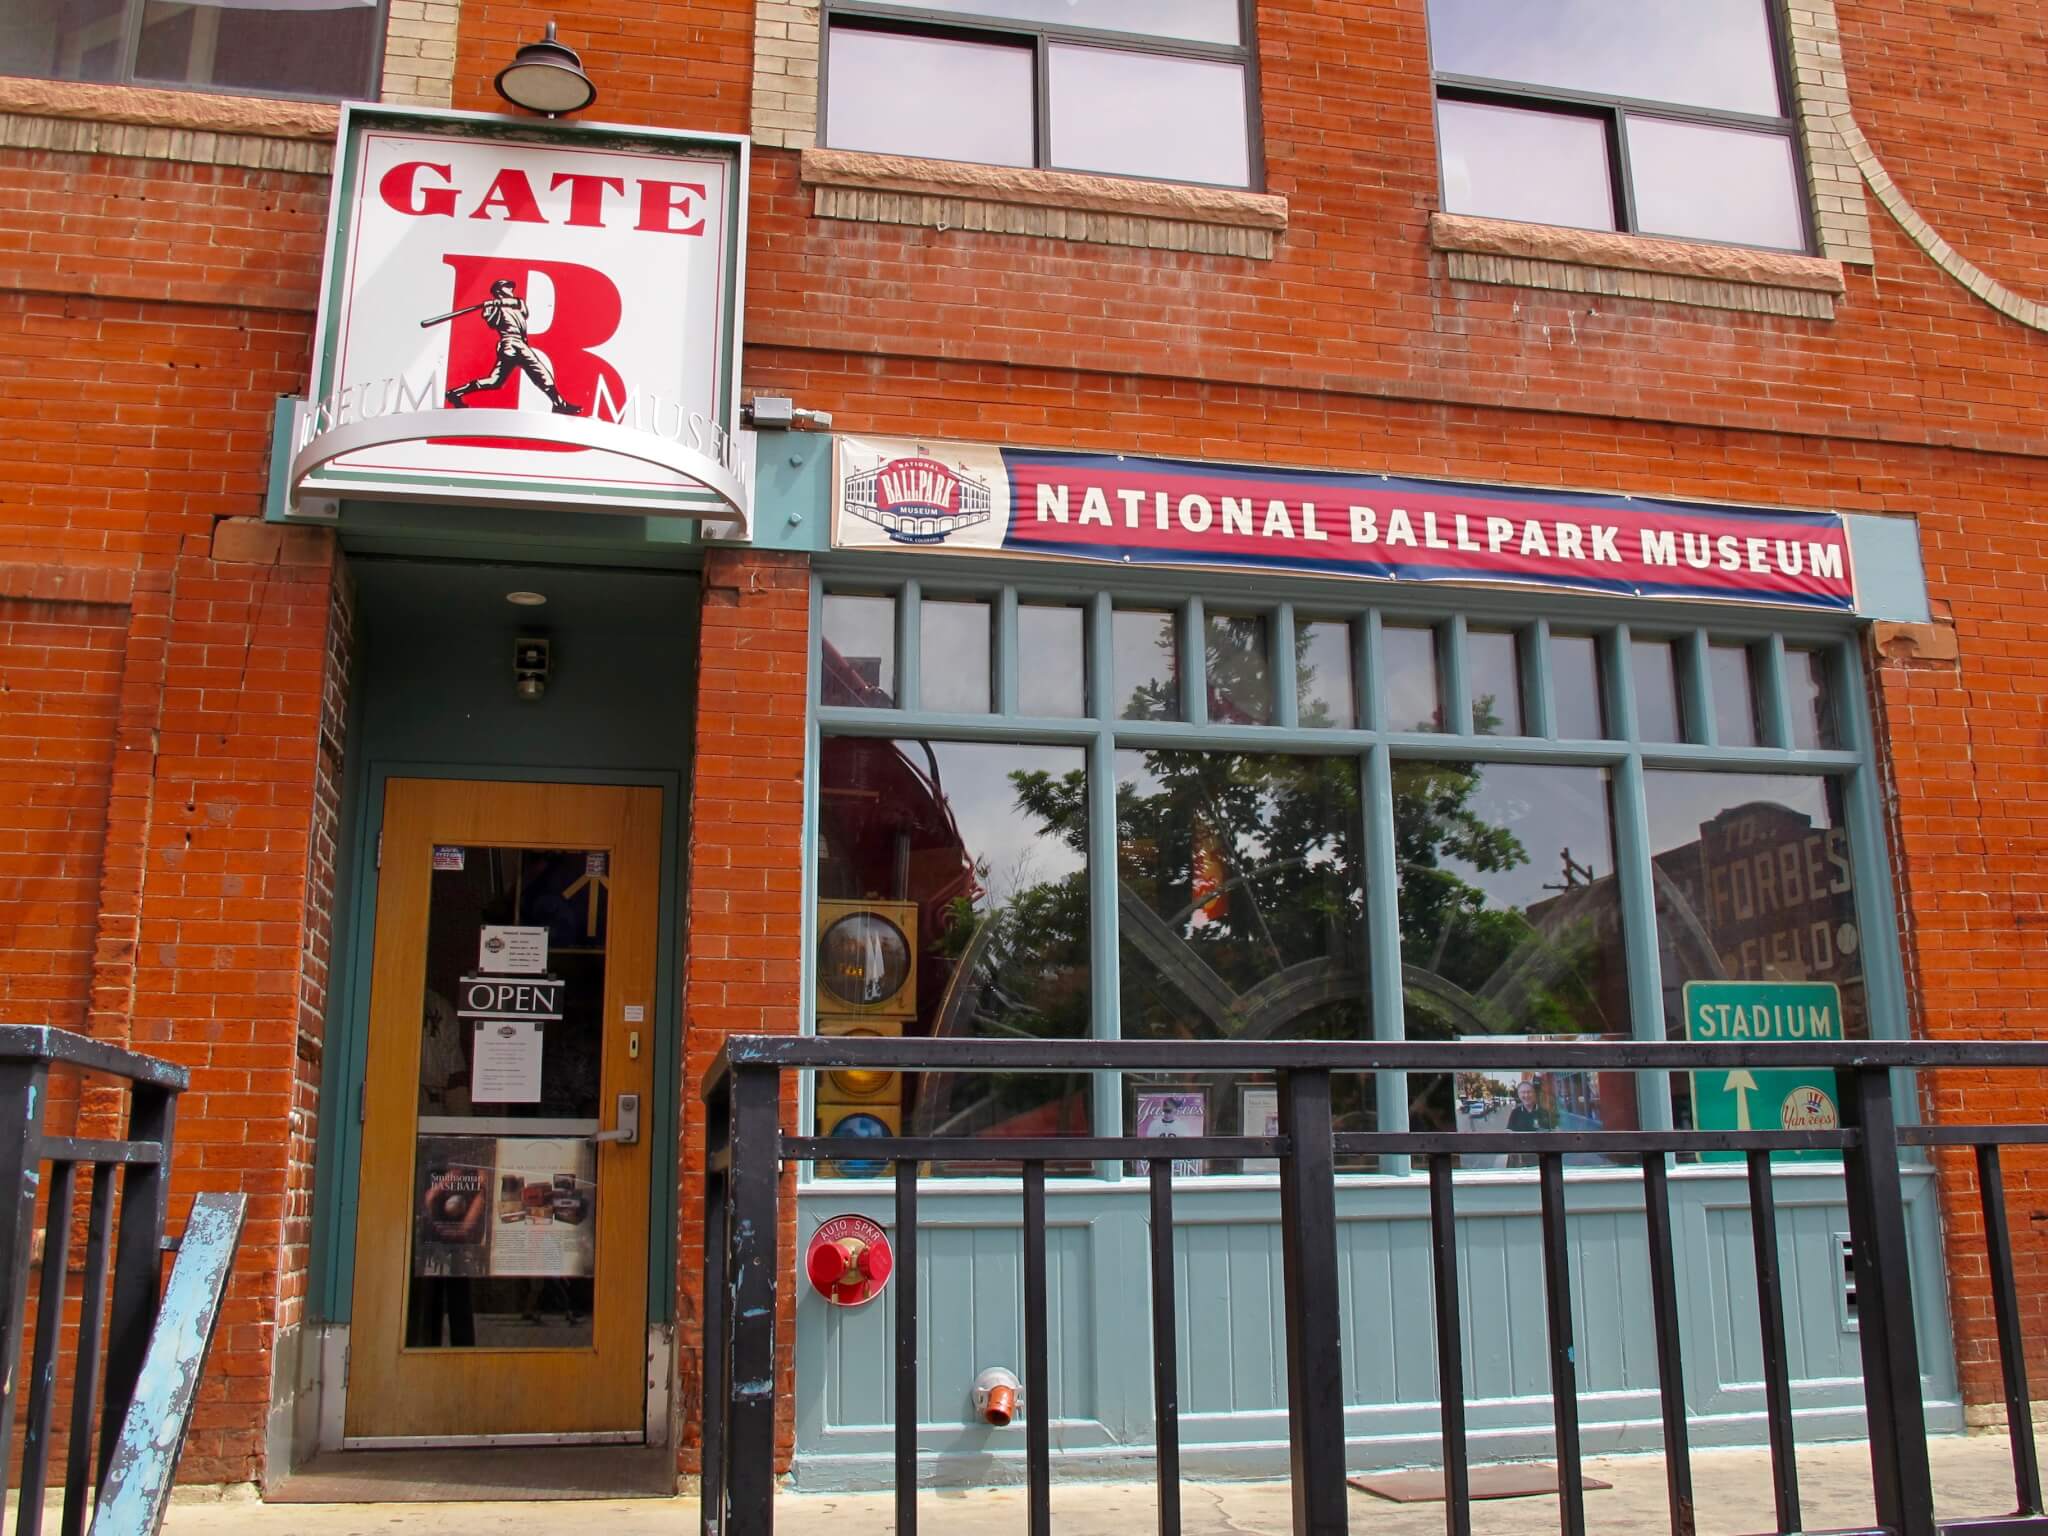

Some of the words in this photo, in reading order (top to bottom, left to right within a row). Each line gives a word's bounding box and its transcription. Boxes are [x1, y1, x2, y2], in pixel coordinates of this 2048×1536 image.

[379, 161, 707, 237] GATE
[898, 461, 940, 472] NATIONAL
[880, 469, 956, 508] BALLPARK
[900, 506, 938, 516] MUSEUM
[1037, 484, 1331, 542] NATIONAL
[1349, 506, 1623, 562] BALLPARK
[1642, 529, 1844, 580] MUSEUM
[1711, 829, 1851, 927] FORBES
[468, 984, 555, 1012] OPEN
[1699, 1004, 1831, 1038] STADIUM
[820, 1220, 847, 1240] AUTO
[854, 1221, 880, 1241] SPKR
